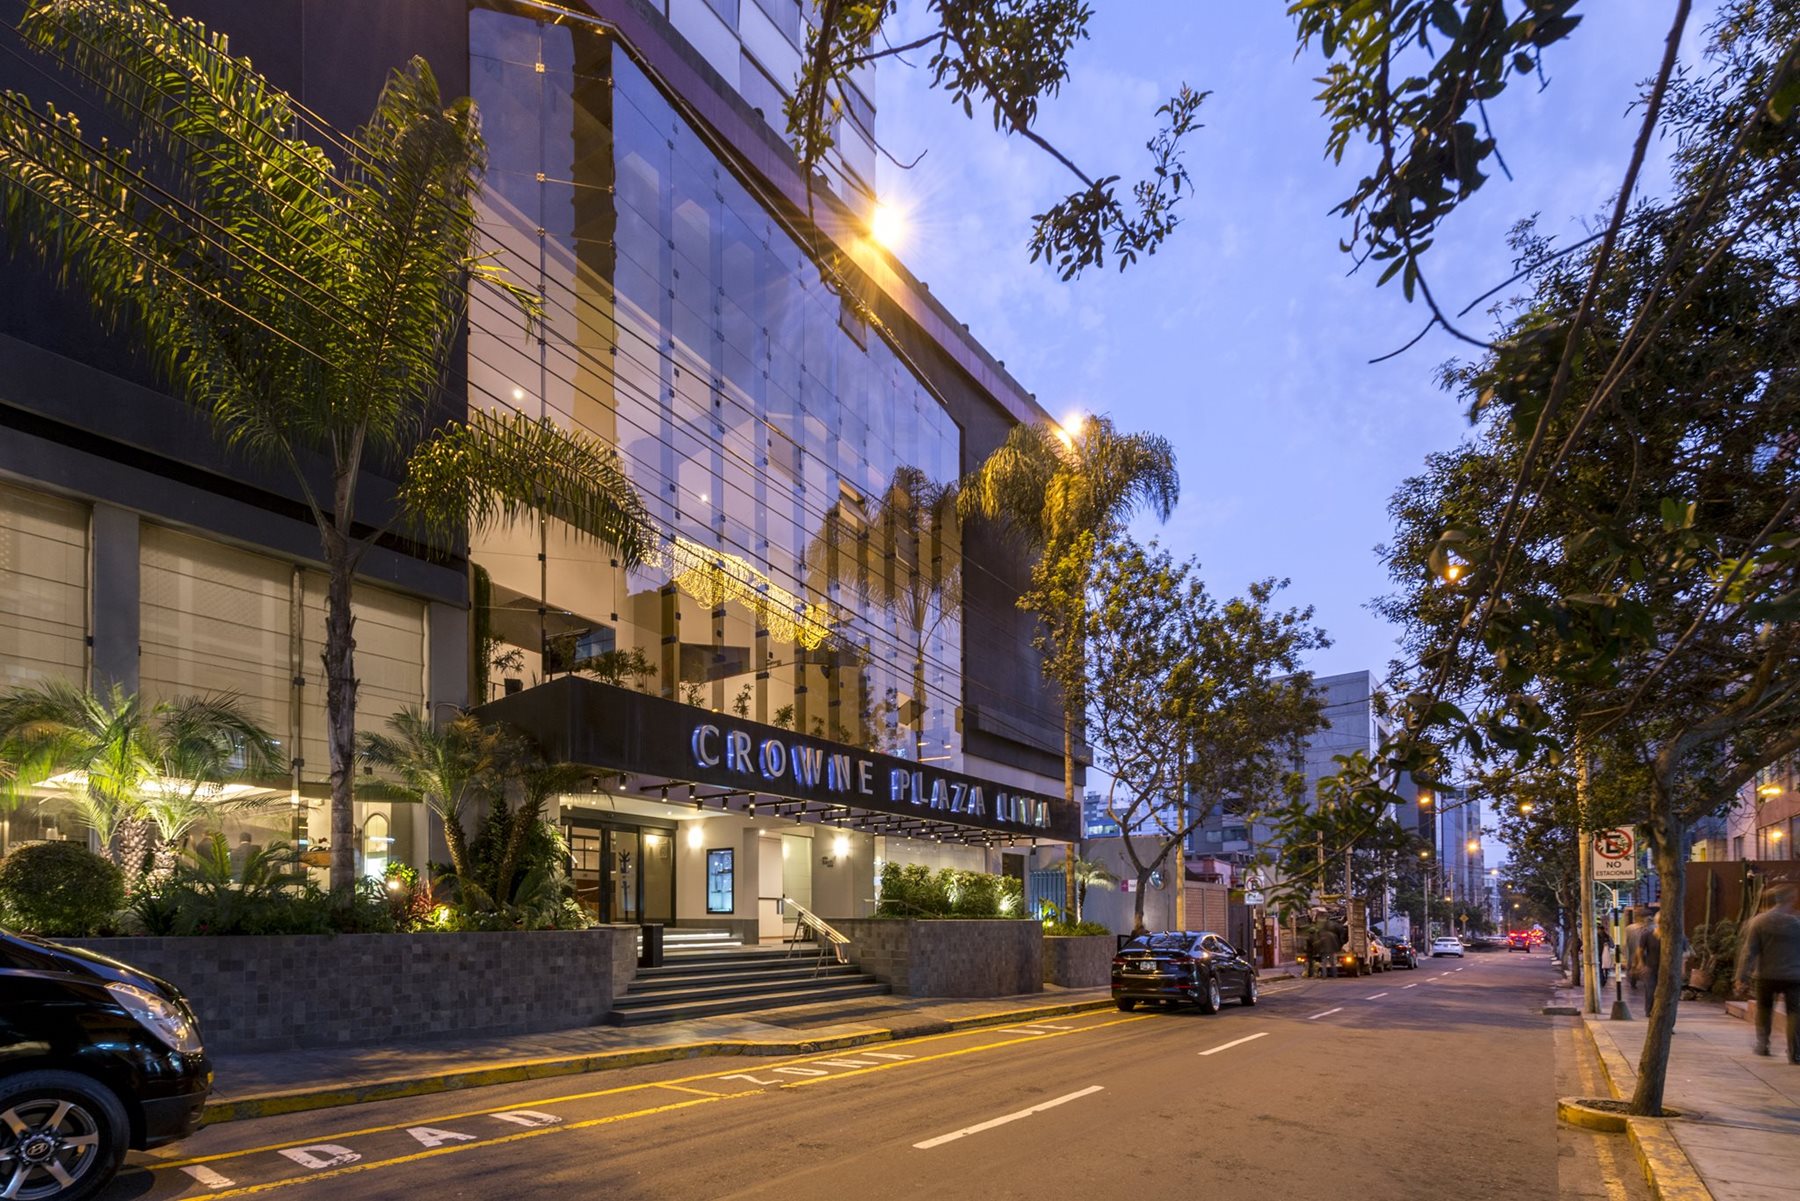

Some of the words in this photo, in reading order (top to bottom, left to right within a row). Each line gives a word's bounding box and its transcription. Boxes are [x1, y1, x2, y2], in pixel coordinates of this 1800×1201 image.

[691, 724, 874, 796] CROWNE
[891, 768, 986, 817] PLAZA
[718, 1052, 916, 1086] ZONA
